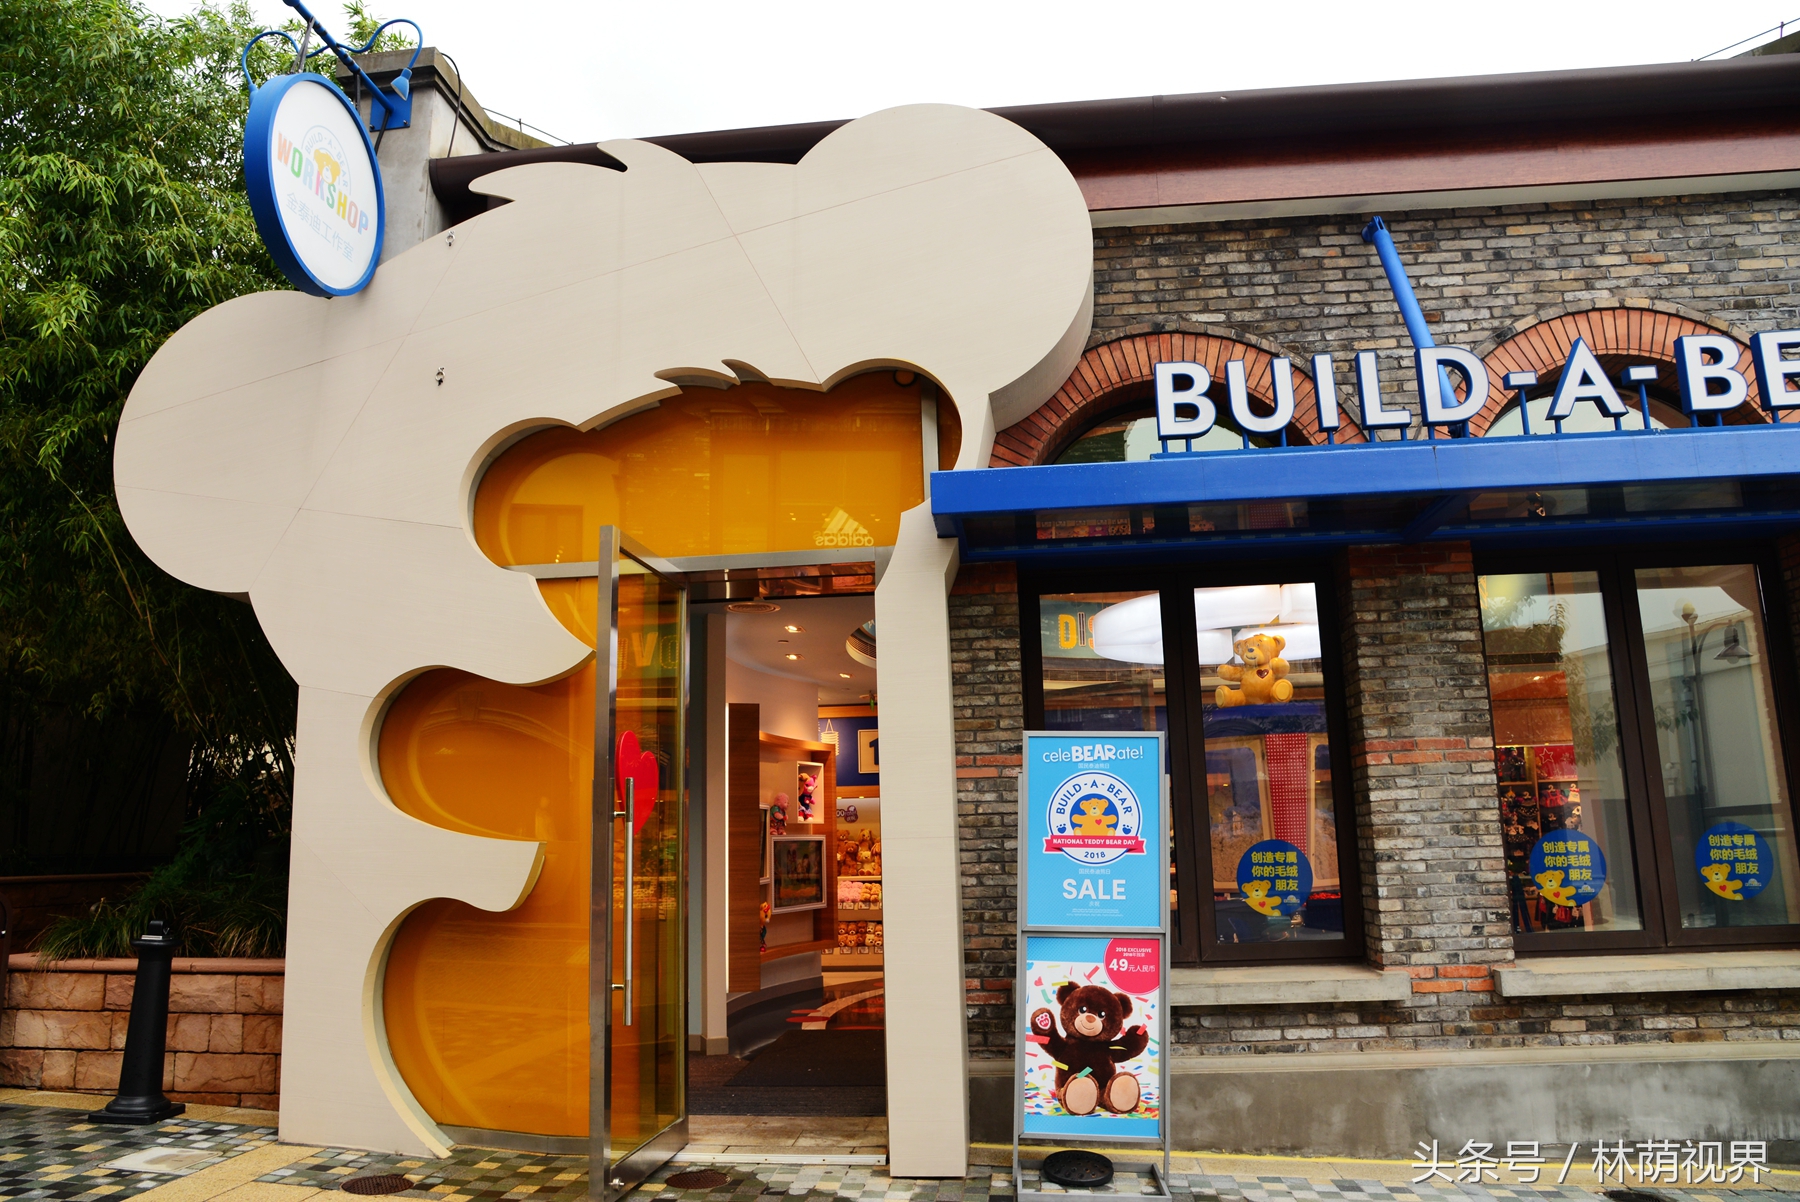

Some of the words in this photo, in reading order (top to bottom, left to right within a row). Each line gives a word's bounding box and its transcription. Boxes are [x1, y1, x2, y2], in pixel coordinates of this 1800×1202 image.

[277, 131, 369, 235] WORKSHOP
[1042, 743, 1144, 763] celeBEARate!
[1084, 838, 1104, 846] TEDDY
[1708, 834, 1756, 846] 创造专属
[1542, 840, 1590, 853] 创造专属
[1084, 851, 1106, 859] 2018
[1251, 851, 1298, 863] 创造专属
[1710, 847, 1758, 860] 你的毛绒
[1544, 854, 1592, 867] 你的毛绒
[1251, 865, 1299, 877] 你的毛绒
[1735, 862, 1759, 874] 朋友
[1568, 868, 1592, 881] 朋友
[1062, 878, 1127, 900] SALE
[1275, 879, 1299, 891] 朋友
